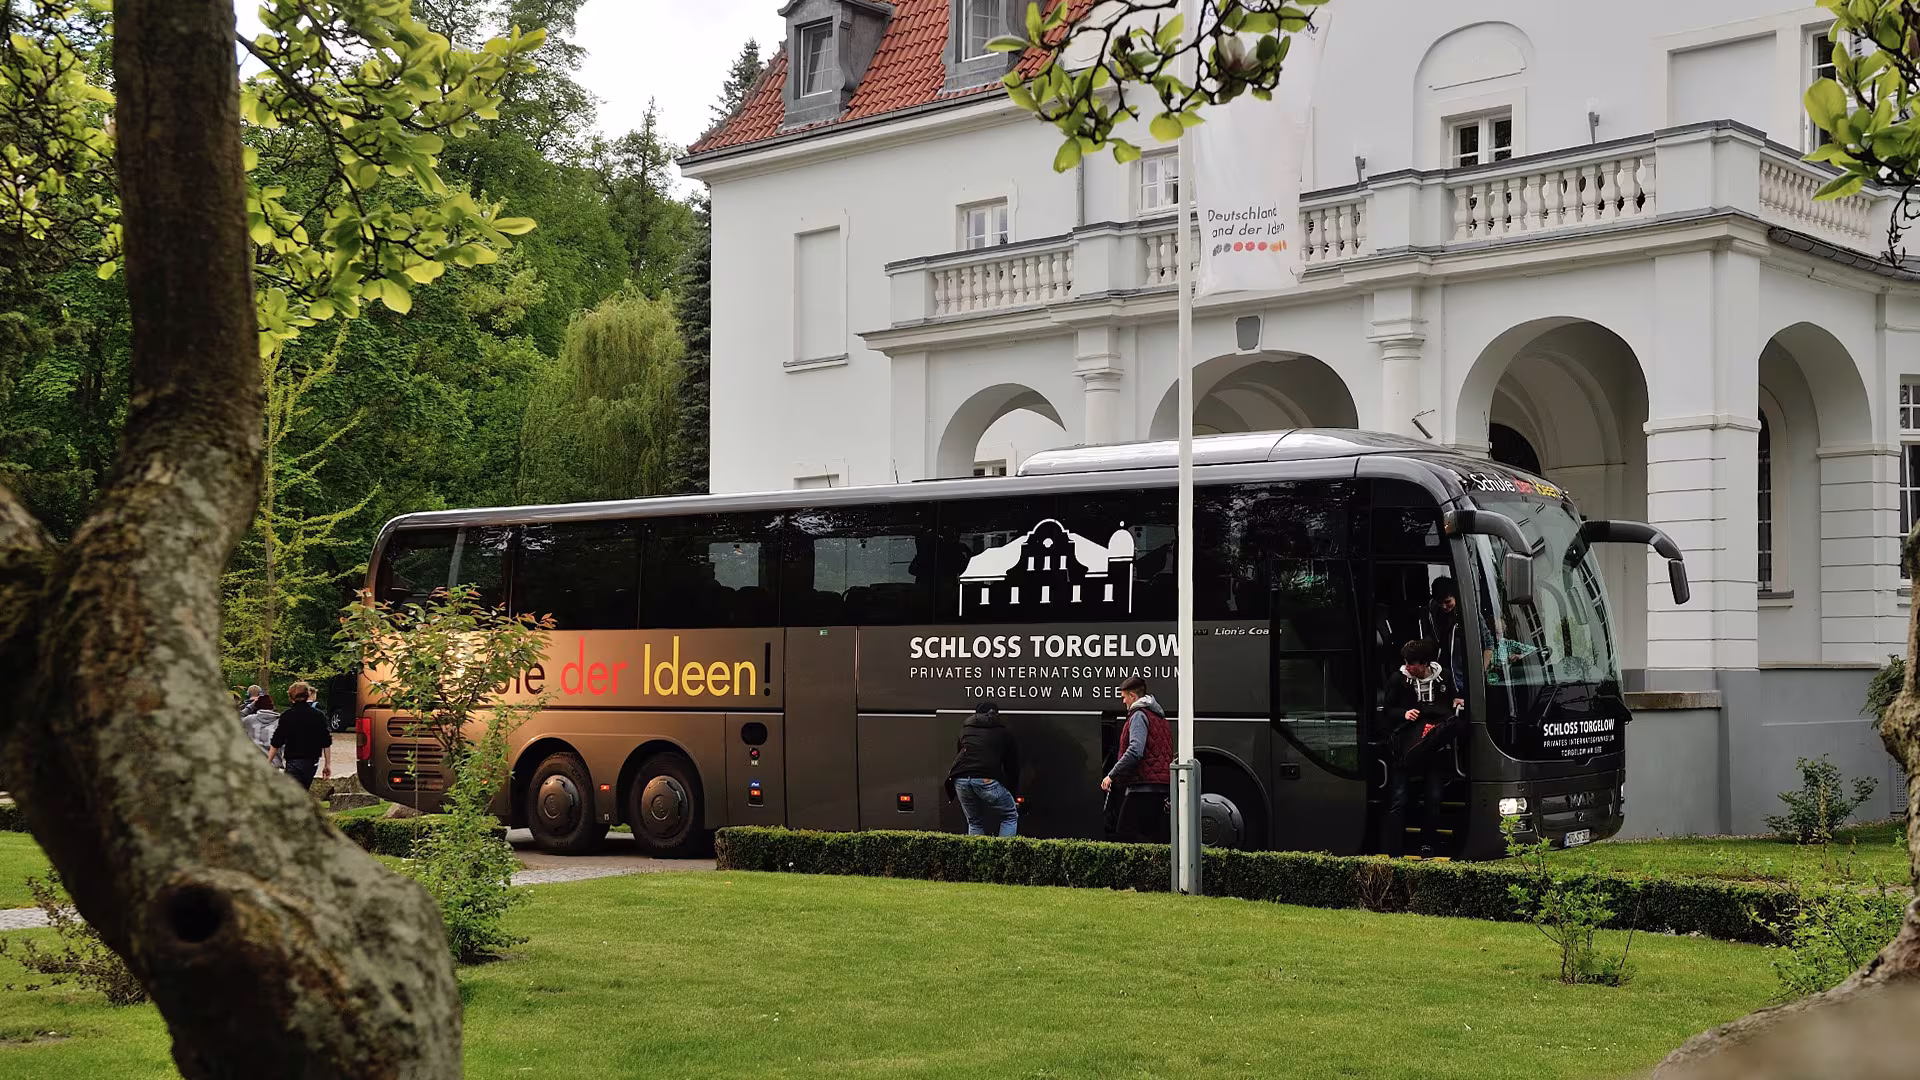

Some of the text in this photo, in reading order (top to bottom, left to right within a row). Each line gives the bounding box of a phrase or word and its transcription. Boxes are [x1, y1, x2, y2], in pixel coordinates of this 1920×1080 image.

[1239, 223, 1262, 236] der
[1469, 473, 1516, 492] Schule
[1214, 626, 1246, 636] Lion's
[909, 633, 1179, 659] SCHLOSS TORGELOW
[560, 635, 628, 696] der
[910, 666, 982, 679] PRIVATES
[965, 686, 1122, 698] TORGELOW AM SEE
[1543, 718, 1615, 737] SCHLOSS TORGELOW
[1543, 738, 1568, 748] PRIVATES
